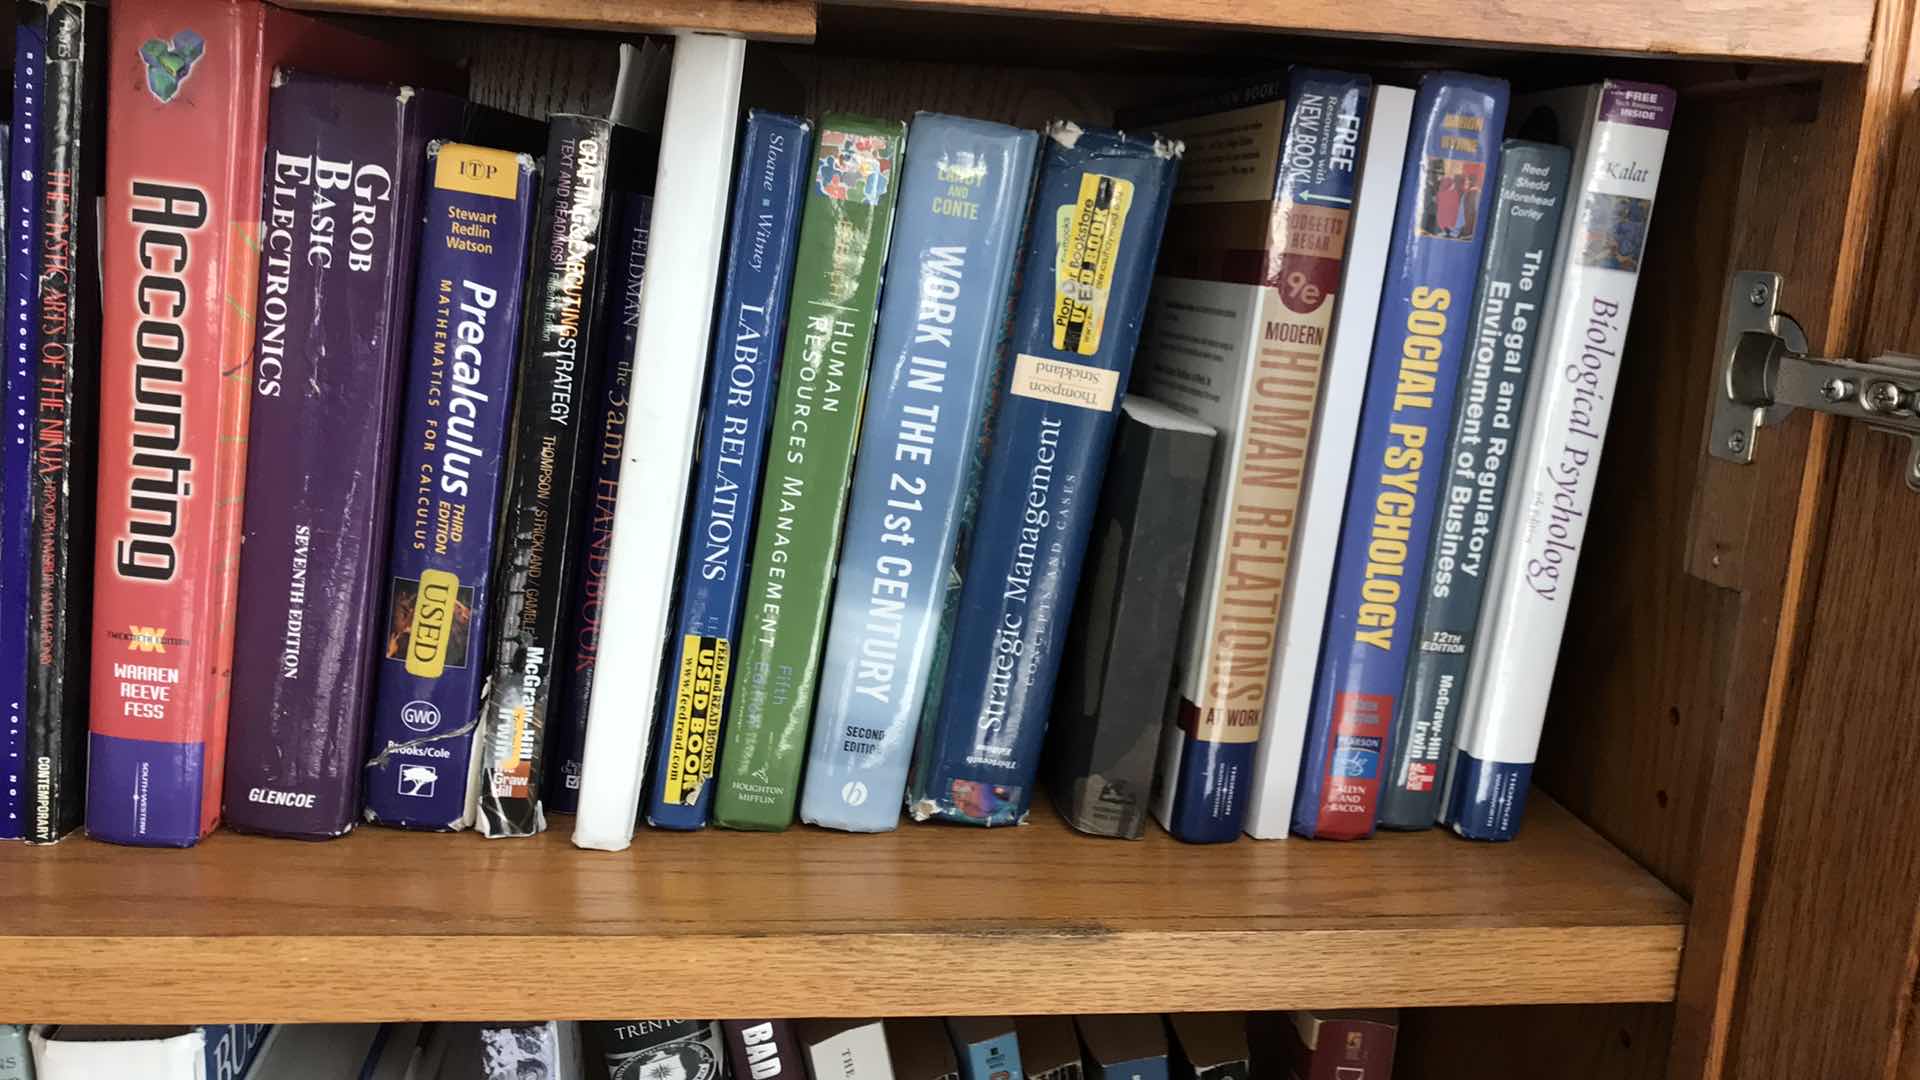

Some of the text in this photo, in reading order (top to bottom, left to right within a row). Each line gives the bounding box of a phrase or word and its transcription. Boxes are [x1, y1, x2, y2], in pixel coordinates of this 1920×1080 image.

[1299, 93, 1324, 133] NEW
[1620, 107, 1657, 121] INSIDE
[1624, 90, 1659, 104] FREE
[1315, 96, 1339, 185] Resources with
[1328, 112, 1362, 173] FREE
[1522, 162, 1551, 177] Reed
[550, 139, 575, 263] TEXT AND READINGS
[1605, 160, 1649, 183] Kalat
[21, 207, 30, 257] JULY
[308, 157, 354, 270] BASIC
[447, 205, 498, 225] Stewart
[451, 221, 491, 240] Redlin
[748, 134, 785, 274] Sloane Witney
[931, 196, 978, 221] CONTE
[1069, 198, 1094, 269] Bookstore
[258, 151, 313, 398] ELECTRONICS
[446, 235, 493, 255] Watson
[623, 226, 650, 328] FELDMAN
[1287, 271, 1321, 305] 9e
[18, 299, 27, 378] AUGUST
[42, 287, 70, 336] ARTS
[1264, 321, 1325, 345] MODERN
[41, 343, 68, 370] OF
[616, 360, 634, 385] the
[823, 321, 857, 412] HUMAN
[1035, 361, 1102, 385] Strickland
[1393, 286, 1452, 413] SOCIAL
[1565, 296, 1619, 438] Biological
[40, 375, 66, 411] THE
[117, 180, 208, 584] Accounting
[441, 279, 498, 498] Precalculus
[549, 336, 579, 428] STRATEGY
[1029, 380, 1099, 405] Thompson
[413, 280, 453, 551] MATHEMATICS FOR CALCULUS
[701, 303, 766, 583] LABOR RELATIONS
[1432, 280, 1512, 599] Environment of Business
[1460, 249, 1544, 577] The Legal and Regulatory
[39, 419, 65, 475] NINJA
[855, 245, 968, 704] WORK IN THE 21st CENTURY
[759, 315, 827, 648] RESOURCES MANAGEMENT
[434, 501, 467, 556] THIRD EDITION
[523, 436, 557, 638] THOMPSON STRICKLAND GAMBLE
[1041, 543, 1064, 580] AND
[1054, 475, 1078, 530] CASES
[1209, 346, 1322, 701] HUMAN RELATIONS
[1354, 424, 1430, 651] PSYCHOLOGY
[1525, 445, 1590, 601] Psychology
[284, 525, 311, 680] SEVENTH EDITION
[576, 479, 620, 674] HANDBOOK
[978, 611, 1024, 732] Strategic
[1002, 418, 1064, 605] Management
[413, 583, 450, 663] USED
[1420, 641, 1466, 654] EDITION
[1432, 631, 1462, 643] 12TH
[113, 662, 179, 684] WARREN
[119, 682, 171, 702] REEVE
[519, 646, 545, 760] McGraw-Hill
[693, 650, 714, 711] USED
[712, 673, 722, 692] and
[773, 664, 793, 705] Fifth
[123, 702, 165, 719] FESS
[403, 706, 437, 727] GWO
[670, 657, 693, 781] www.feedread.com
[709, 693, 722, 726] READ
[845, 725, 886, 741] SECOND
[1410, 720, 1431, 759] Irwin
[1426, 675, 1455, 760] McGraw-Hill
[387, 740, 450, 760] Brooks/Cole
[36, 757, 52, 840] CONTEMPORARY
[248, 786, 317, 809] GLENCOE
[213, 1023, 264, 1080] BU
[741, 1021, 782, 1080] BAD
